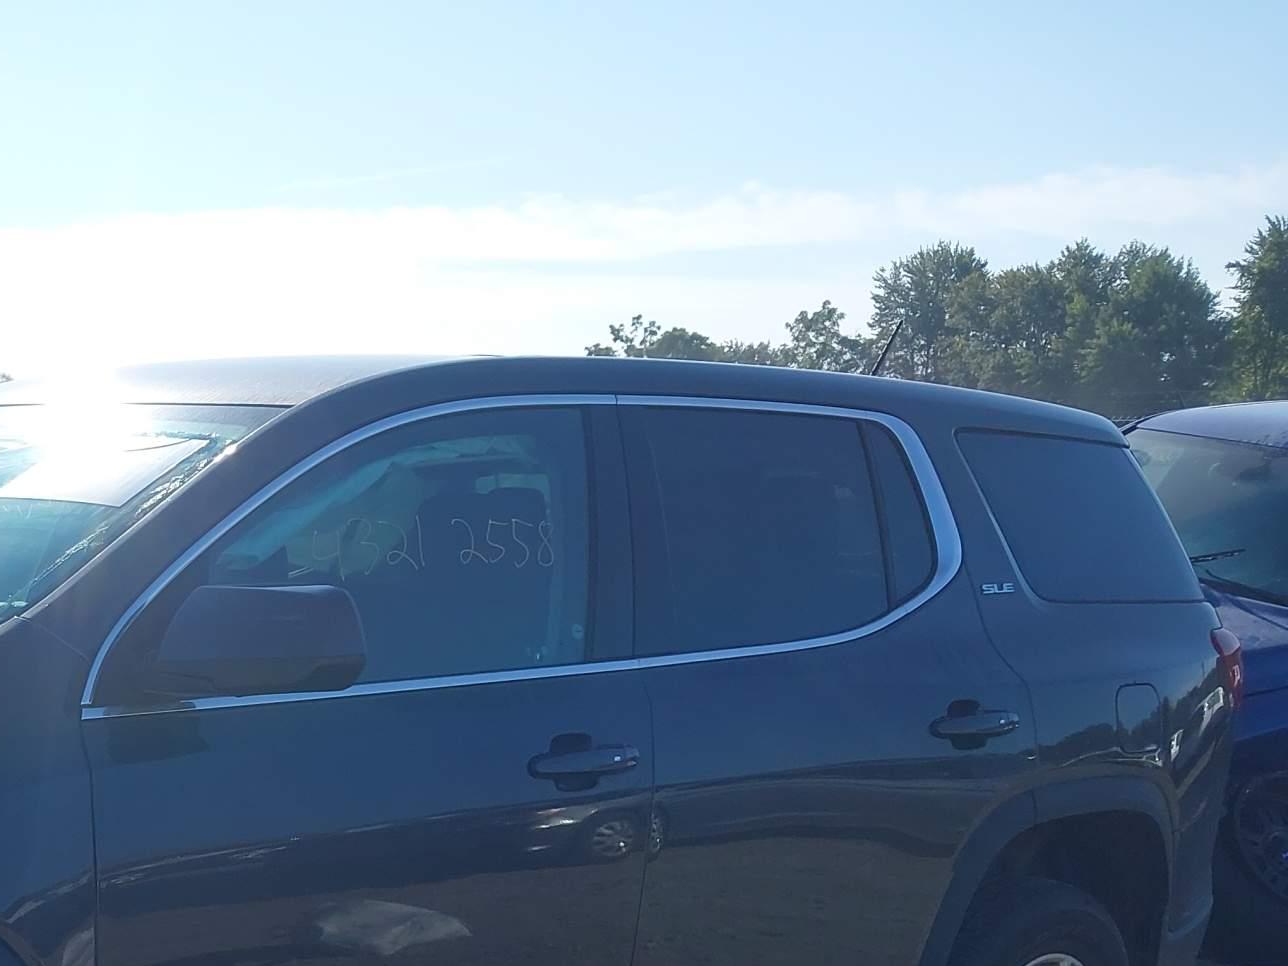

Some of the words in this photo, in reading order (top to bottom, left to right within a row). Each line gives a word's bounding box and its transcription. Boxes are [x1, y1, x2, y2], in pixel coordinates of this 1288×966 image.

[311, 514, 427, 582] 4321
[450, 517, 557, 569] 2558
[981, 582, 1016, 595] SLE
